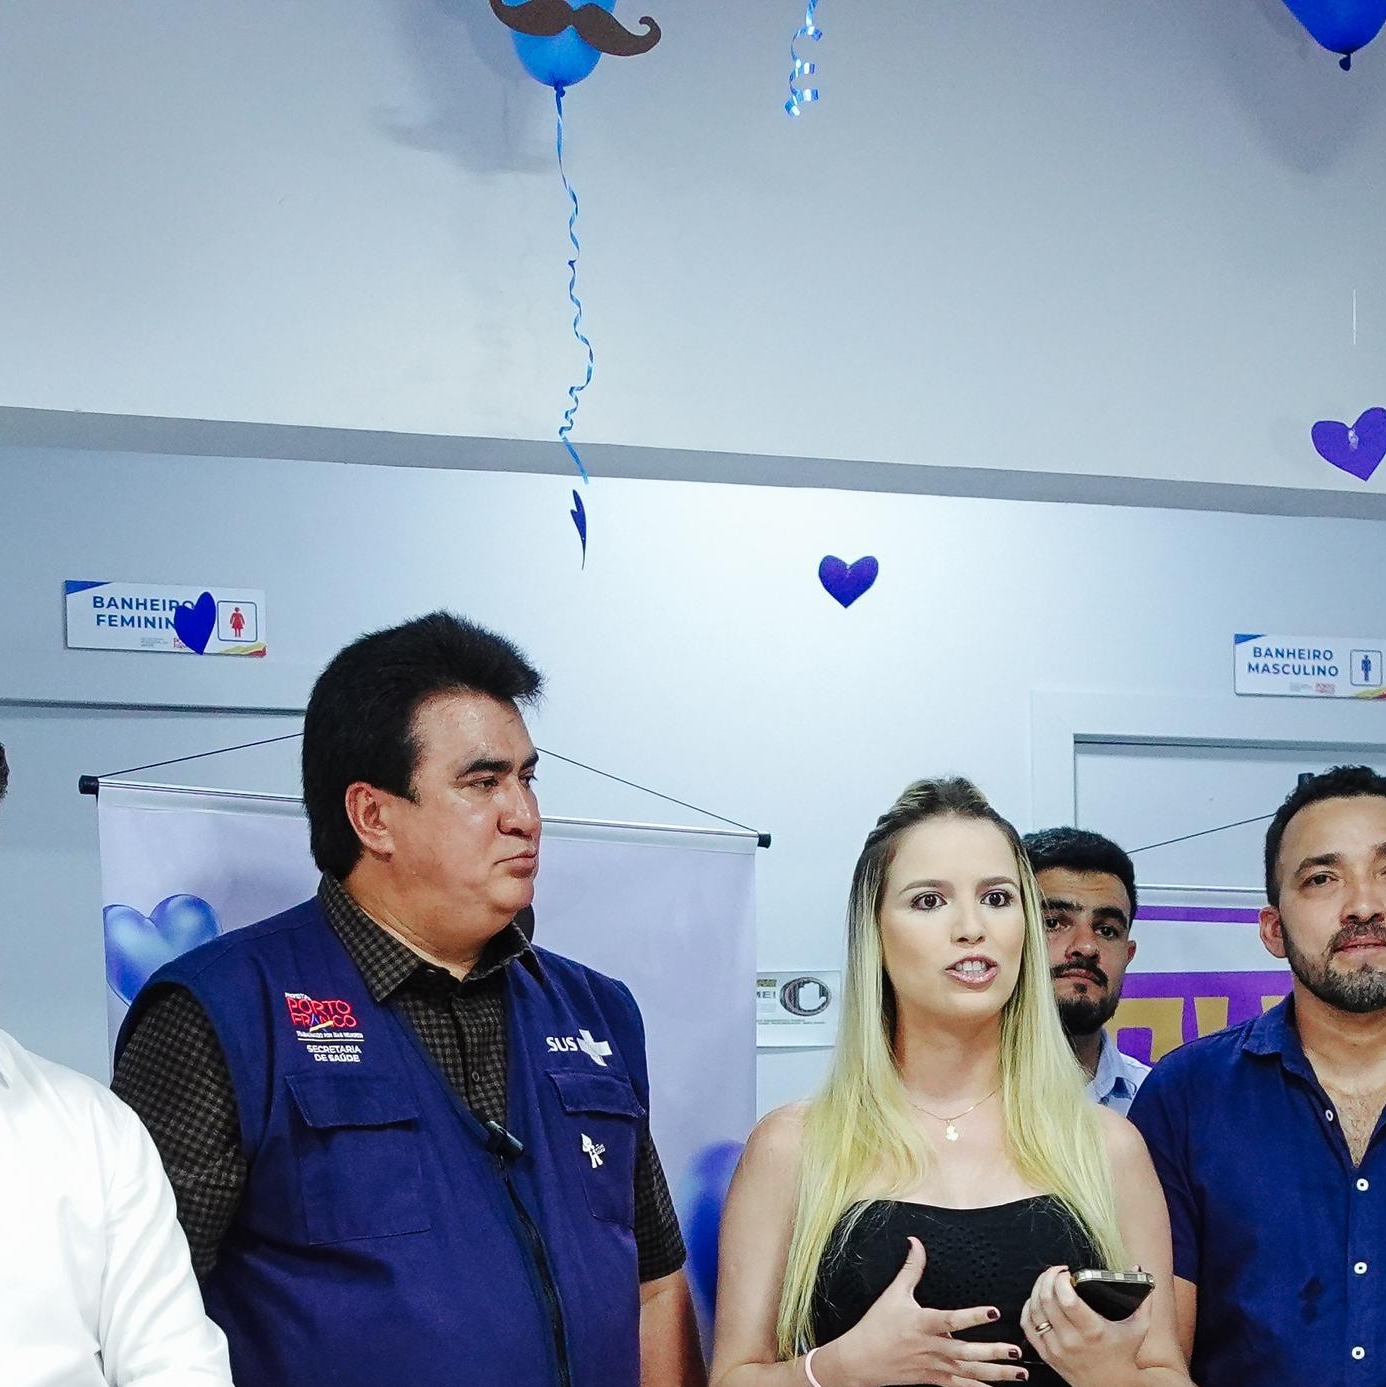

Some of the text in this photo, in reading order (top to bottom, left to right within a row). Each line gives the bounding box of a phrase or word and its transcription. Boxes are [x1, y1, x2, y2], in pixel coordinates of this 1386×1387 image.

[96, 614, 176, 629] FEMININ
[1253, 646, 1334, 661] BANHEIRO
[1247, 662, 1339, 677] MASCULINO
[286, 997, 351, 1015] PORTO
[291, 1012, 357, 1028] FRANCO
[306, 1044, 362, 1054] SECRETARIA
[546, 1036, 578, 1052] SUS
[313, 1054, 328, 1062] DE
